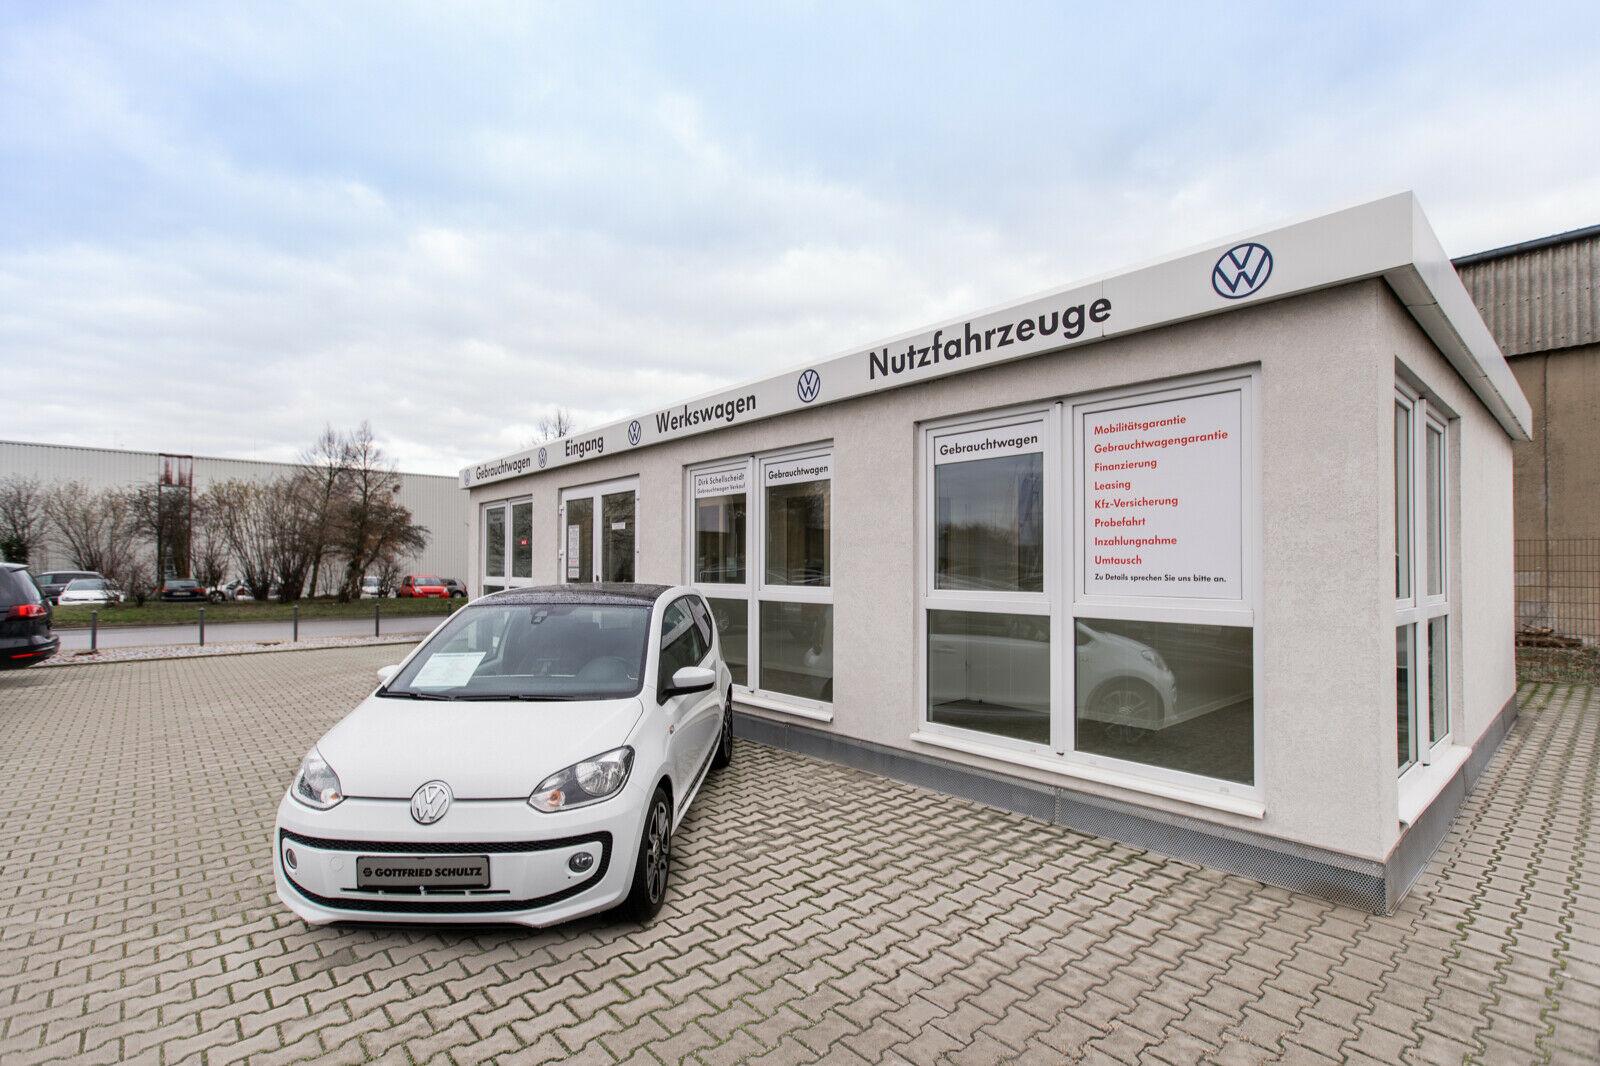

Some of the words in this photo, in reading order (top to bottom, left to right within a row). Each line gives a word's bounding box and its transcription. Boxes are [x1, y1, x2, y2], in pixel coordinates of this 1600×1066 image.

[1211, 242, 1274, 300] VW
[869, 298, 1112, 380] Nutzfahrzeuge
[796, 368, 821, 403] VW
[656, 394, 756, 434] Werkswagen
[627, 420, 642, 446] VW
[1094, 415, 1186, 435] Mobilitätsgarantie
[565, 436, 604, 458] Eingang
[939, 433, 1038, 457] Gebrauchtwagen
[1094, 430, 1228, 454] Gebrauchtwagengarantie
[476, 456, 531, 480] Gebrauchtwagen
[768, 466, 829, 480] Gebrauchtwagen
[1094, 460, 1157, 472] Finanzierung
[698, 477, 709, 486] Dirk
[1094, 481, 1131, 491] Leasing
[1094, 497, 1178, 509] Kfz-Versicherung
[1094, 516, 1146, 527] Probefahrt
[1094, 535, 1178, 548] Inzahlungnahme
[1094, 555, 1142, 565] Umtausch
[1094, 573, 1104, 581] Zu
[1105, 573, 1129, 581] Details
[1130, 574, 1162, 583] sprechen
[1164, 574, 1176, 582] Sie
[1193, 574, 1211, 582] bitte
[411, 780, 452, 825] VW
[375, 868, 433, 877] GOTTFRIED
[435, 867, 482, 877] SCHULTZ
